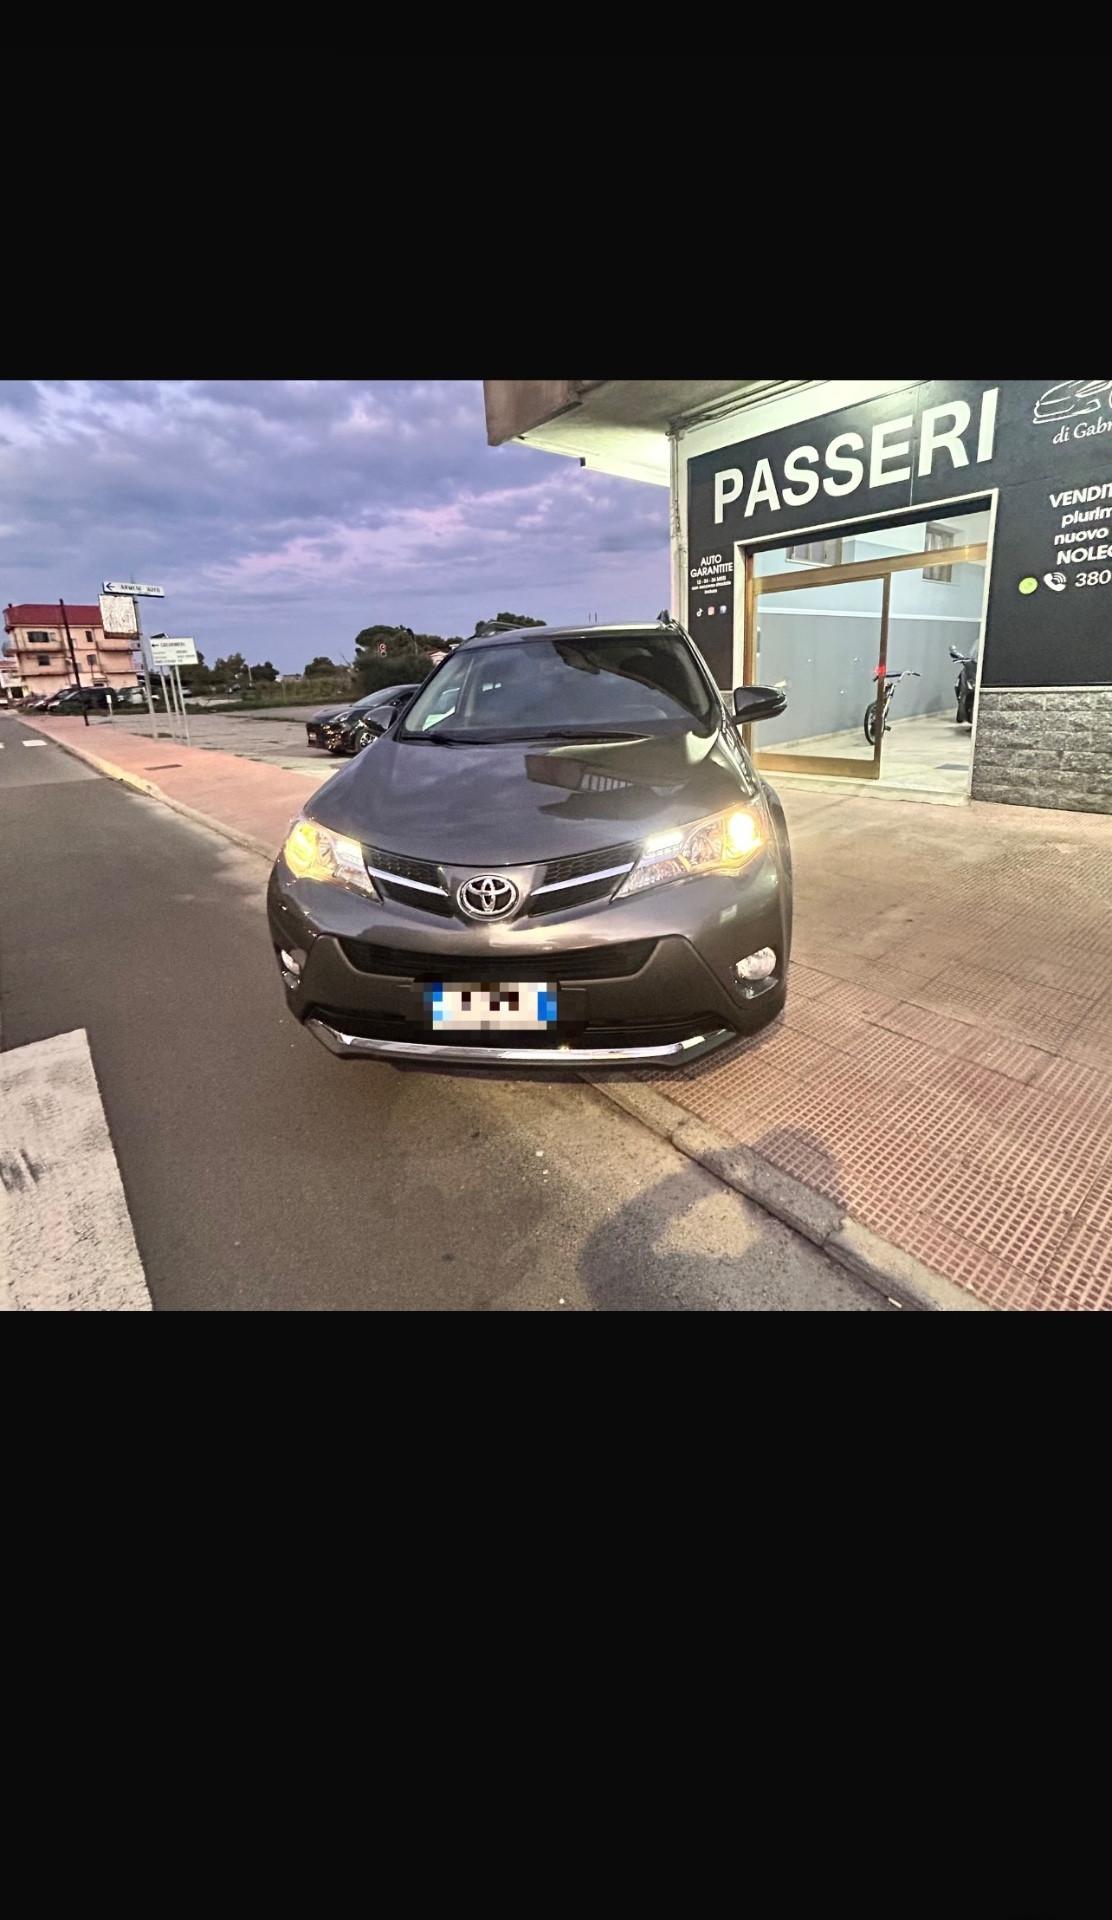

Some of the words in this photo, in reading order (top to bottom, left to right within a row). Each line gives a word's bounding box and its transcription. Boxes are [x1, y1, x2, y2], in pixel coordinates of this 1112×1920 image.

[1052, 425, 1070, 444] di
[714, 387, 999, 524] PASSERI
[1054, 527, 1109, 545] nuovo
[701, 554, 722, 567] AUTO
[690, 562, 734, 578] GARANTITE
[1075, 569, 1111, 587] 380
